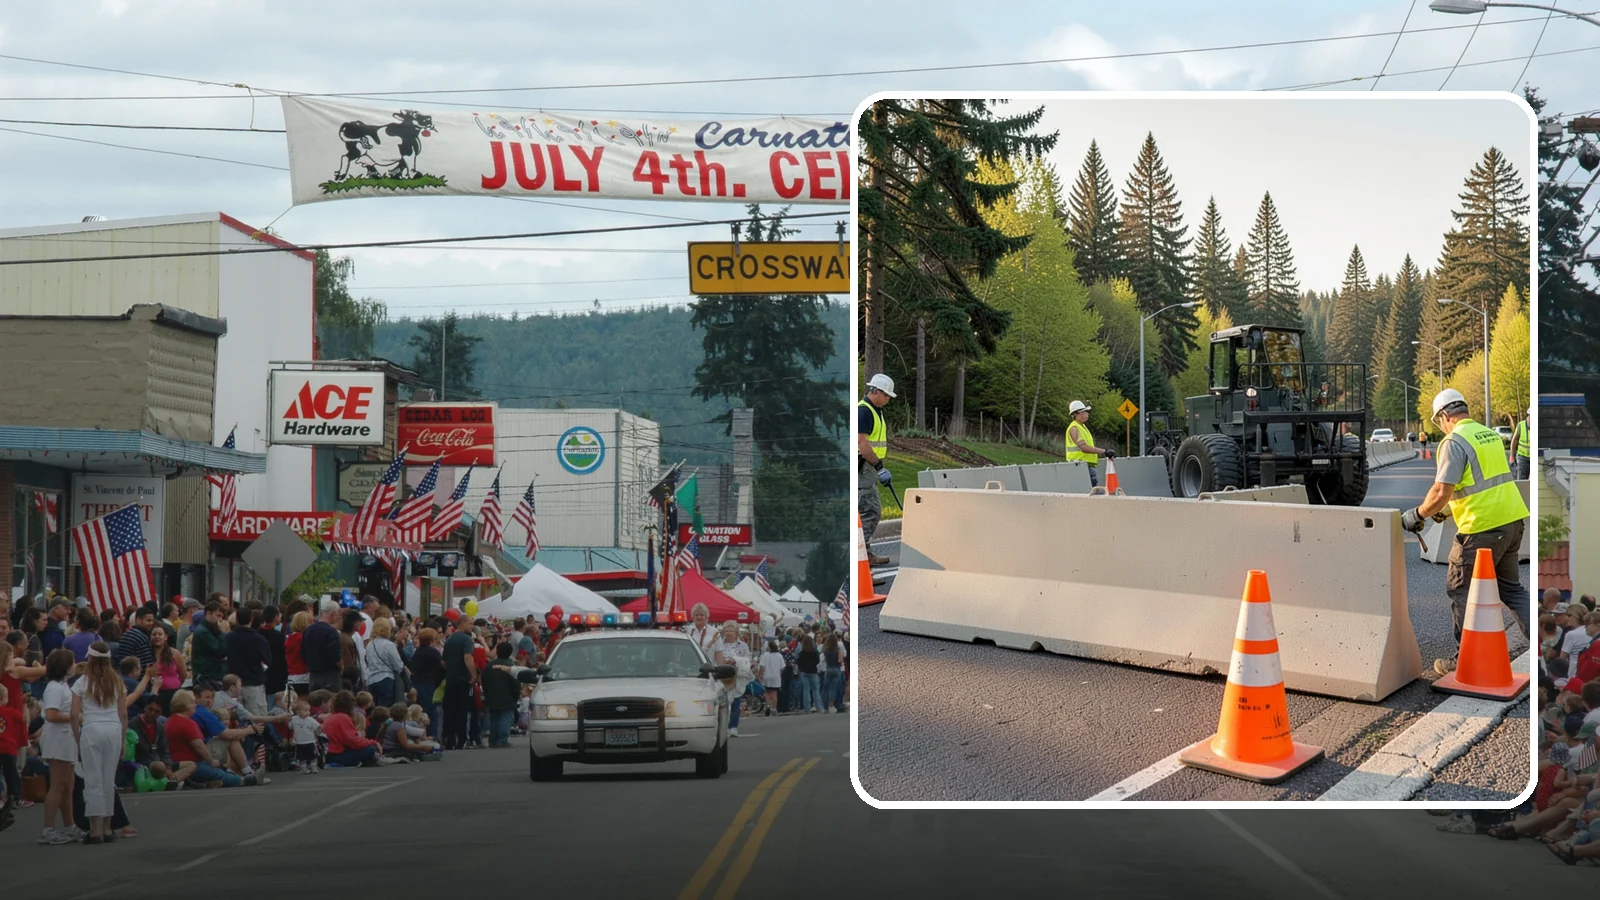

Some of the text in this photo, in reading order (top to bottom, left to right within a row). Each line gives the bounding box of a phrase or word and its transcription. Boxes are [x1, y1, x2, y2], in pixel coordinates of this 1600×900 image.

[481, 141, 605, 192] JULY
[632, 150, 746, 198] 4th.
[697, 254, 850, 280] CROSSWA
[282, 380, 373, 419] ACE
[405, 409, 453, 422] CEDAR
[284, 421, 370, 436] Hardware
[416, 428, 476, 447] Coca-Cola
[353, 467, 386, 480] Simpl
[96, 485, 124, 494] Vincent
[126, 486, 135, 494] de
[138, 486, 155, 495] Paul
[688, 526, 741, 535] CRNATION
[699, 535, 730, 543] GLASS
